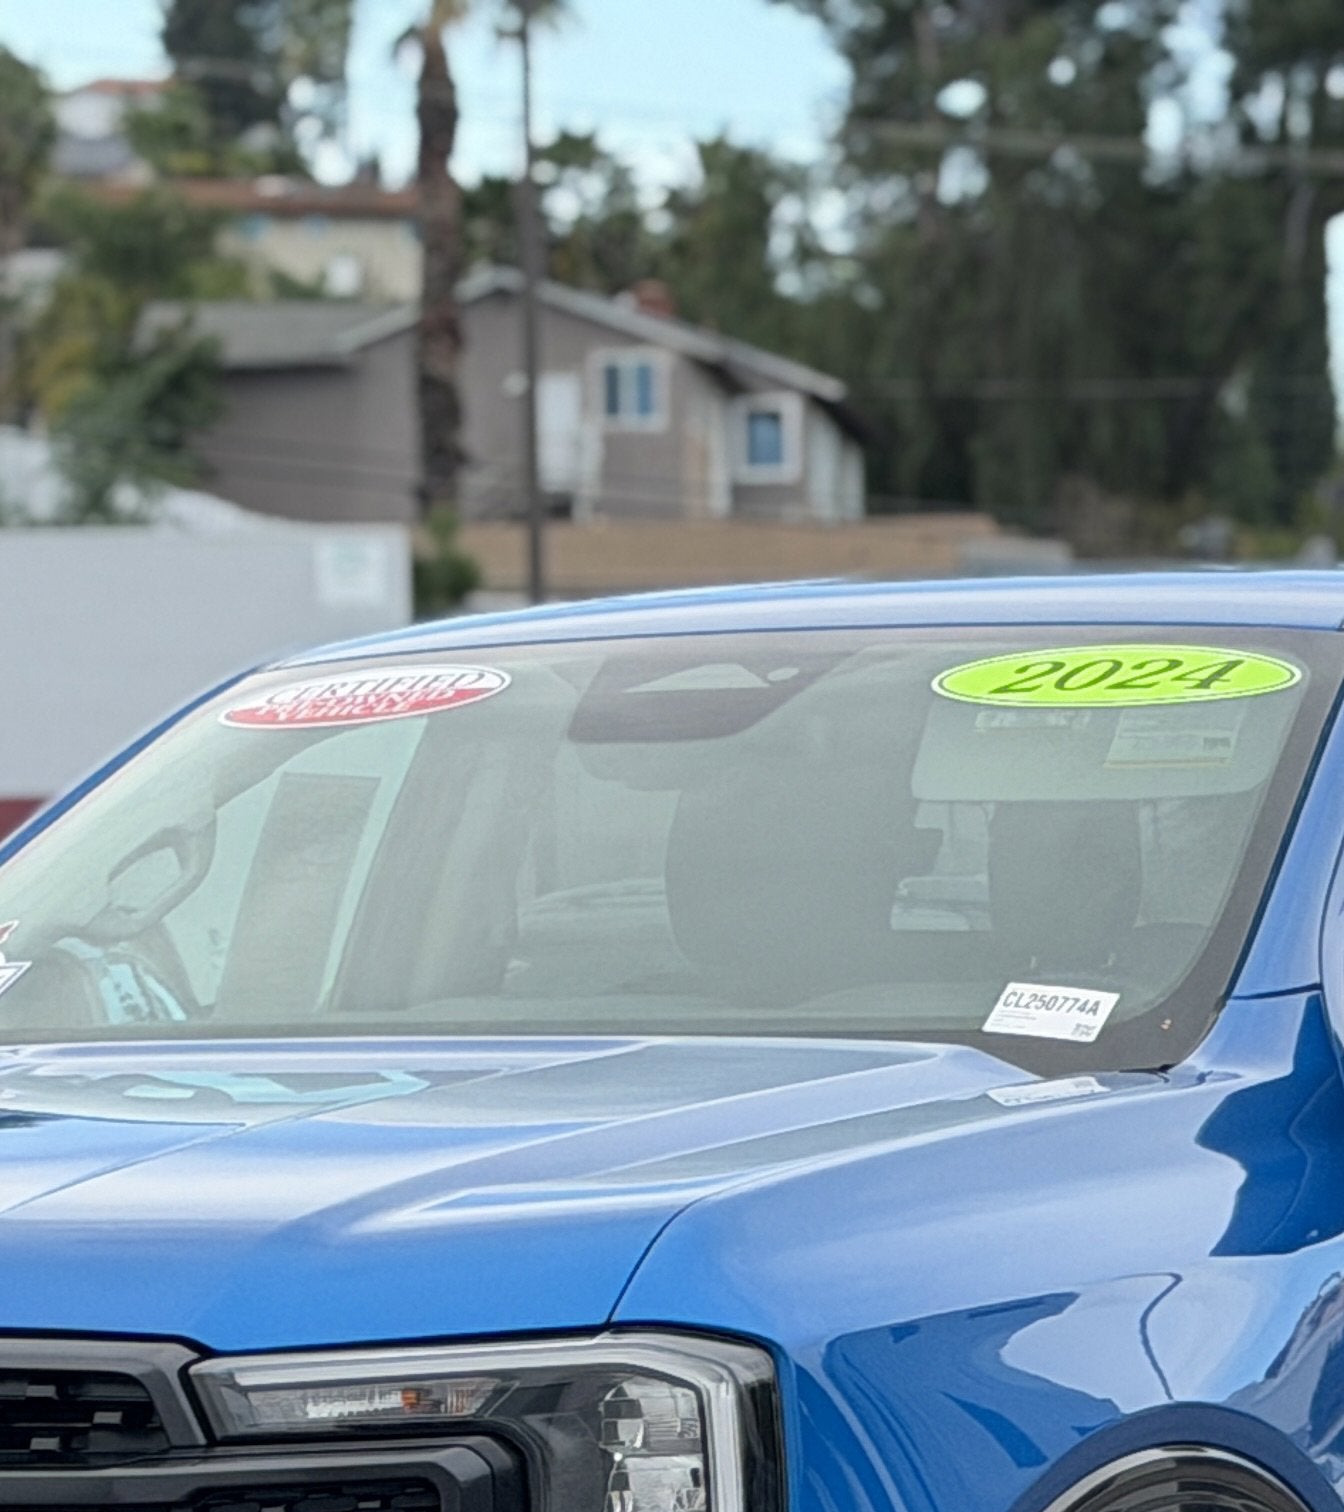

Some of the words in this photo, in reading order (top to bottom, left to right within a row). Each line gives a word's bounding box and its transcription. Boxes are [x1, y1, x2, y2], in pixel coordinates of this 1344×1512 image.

[266, 672, 486, 705] CERTIFIED
[988, 658, 1245, 694] 2024
[276, 701, 412, 721] VEHICLE
[1002, 991, 1102, 1017] CL250774A
